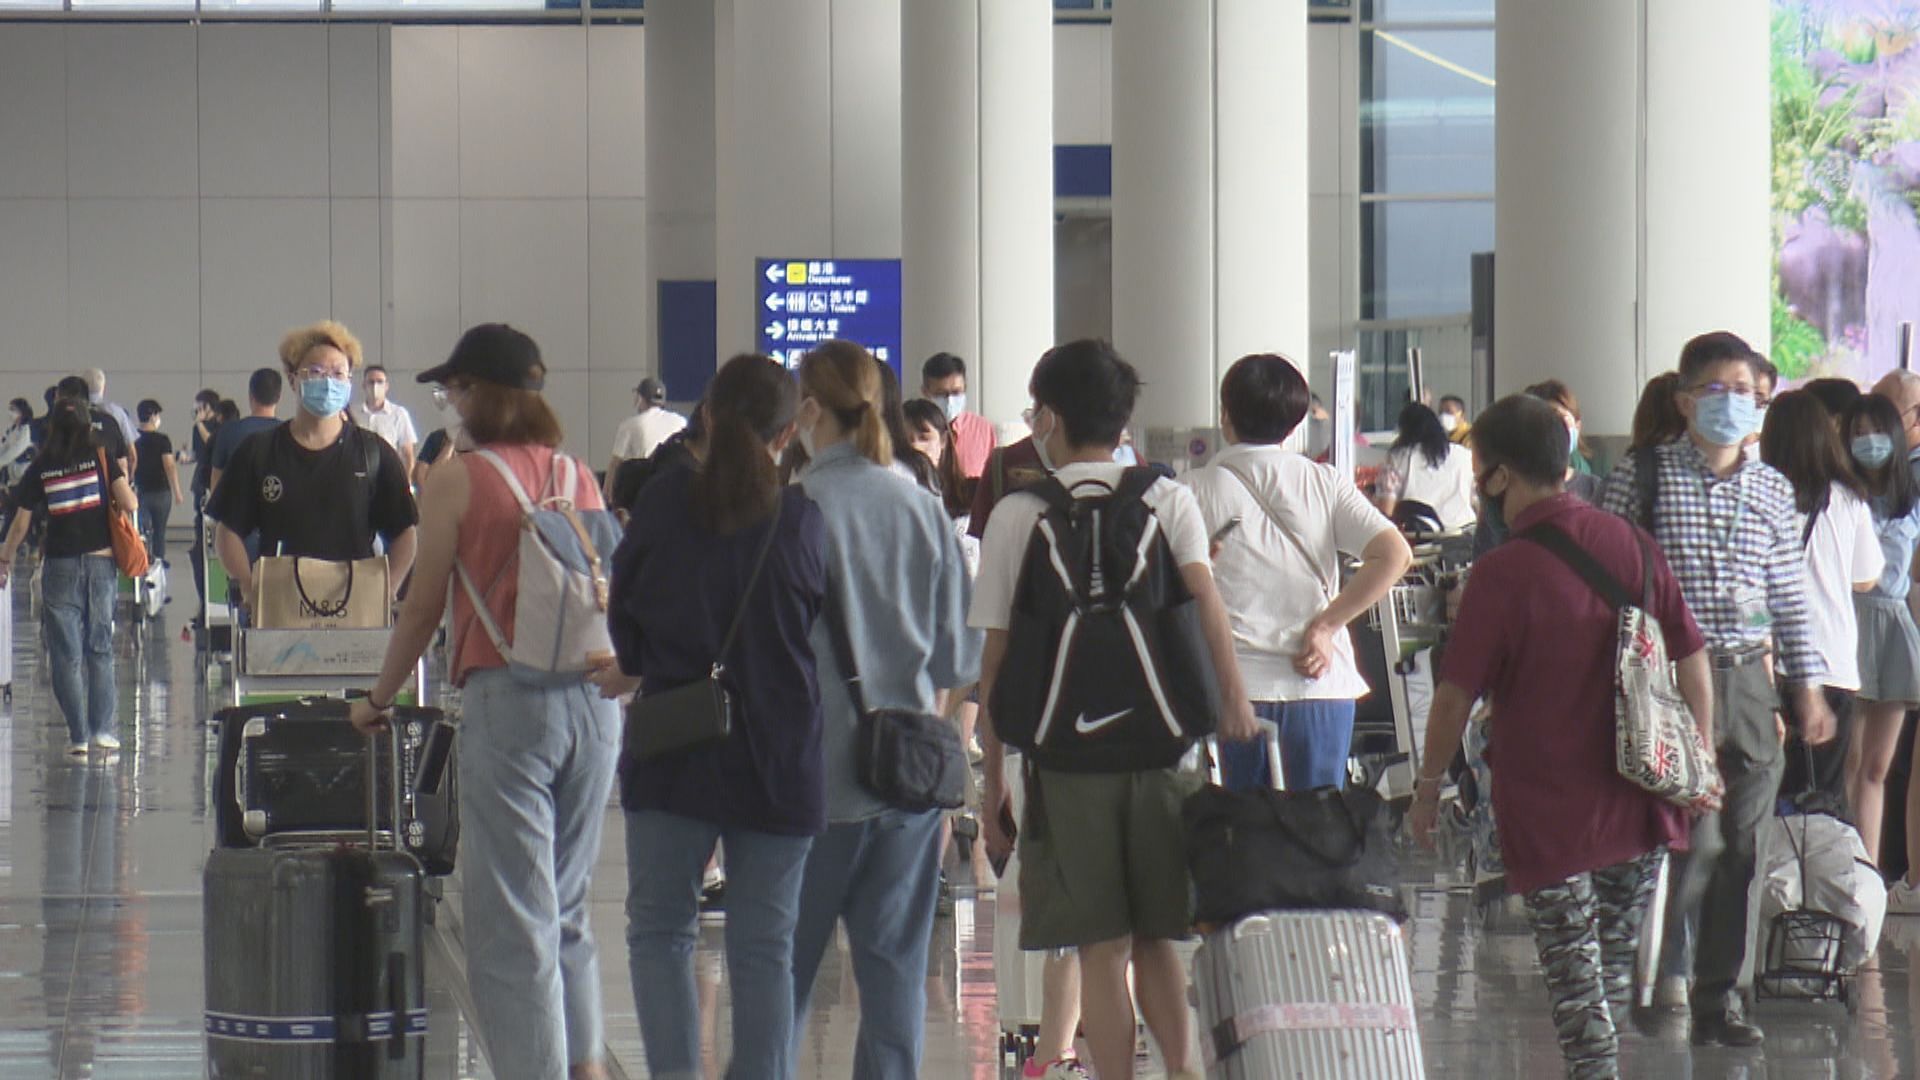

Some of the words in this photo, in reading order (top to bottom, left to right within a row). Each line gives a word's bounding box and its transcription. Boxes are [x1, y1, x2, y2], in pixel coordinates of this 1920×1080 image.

[807, 275, 851, 285] Departures
[830, 290, 868, 304] 洗手間
[831, 304, 856, 313] Toilets
[299, 600, 347, 618] M&S
